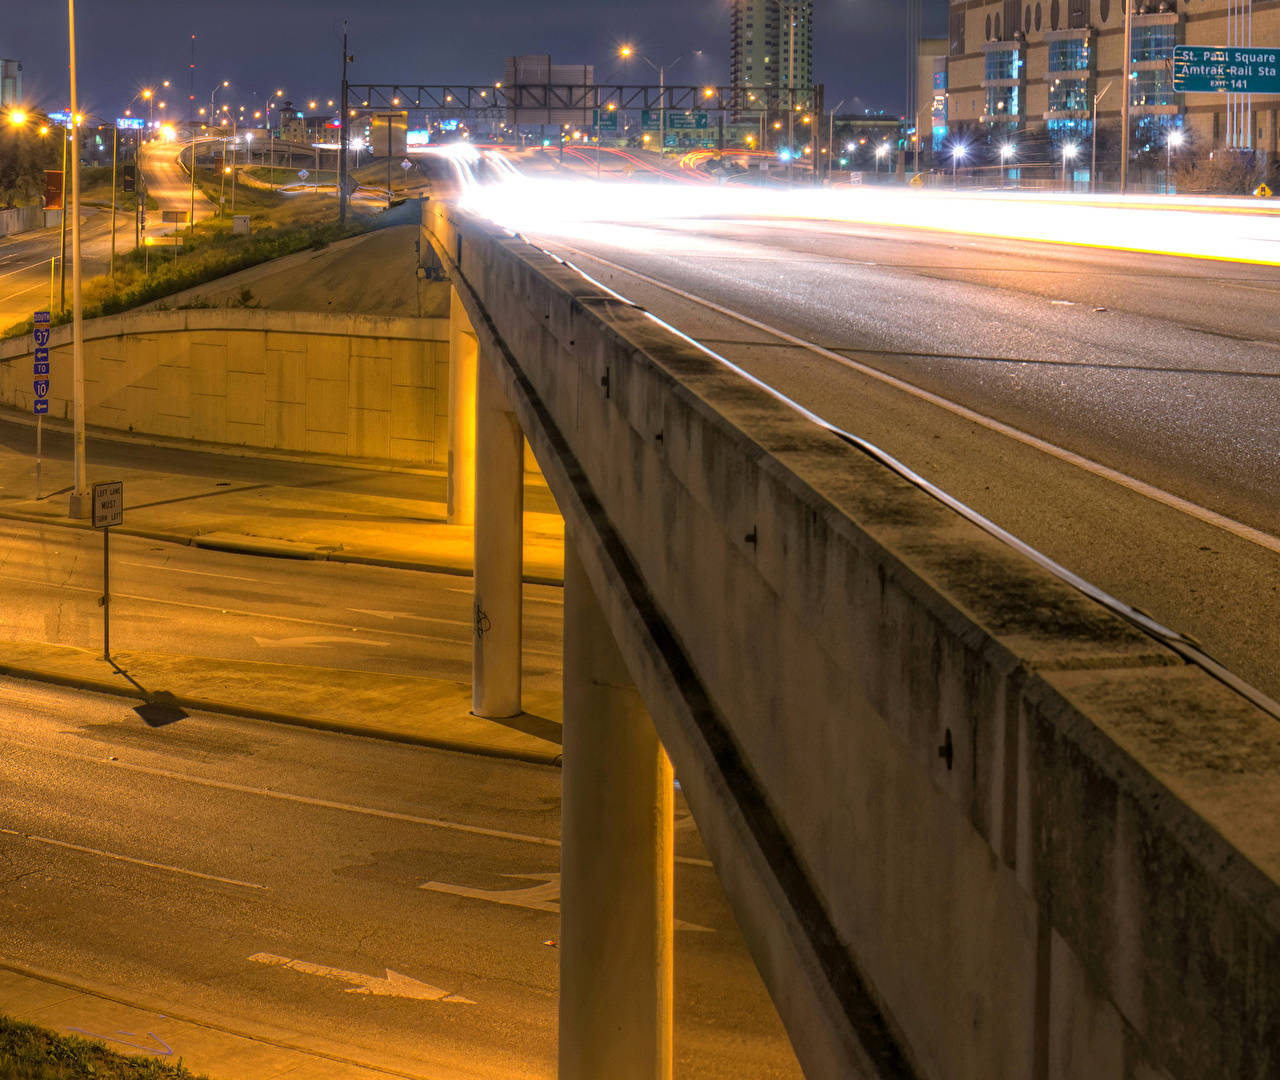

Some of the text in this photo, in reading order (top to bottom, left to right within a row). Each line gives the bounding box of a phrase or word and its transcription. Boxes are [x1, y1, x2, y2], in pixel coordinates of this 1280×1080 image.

[1182, 51, 1276, 64] St. Paul Square
[1181, 65, 1276, 76] Amtrak Rail Sta
[1230, 80, 1247, 88] 141
[36, 331, 48, 344] 37
[37, 364, 46, 373] TO
[37, 383, 46, 395] 10
[101, 499, 116, 509] MUST
